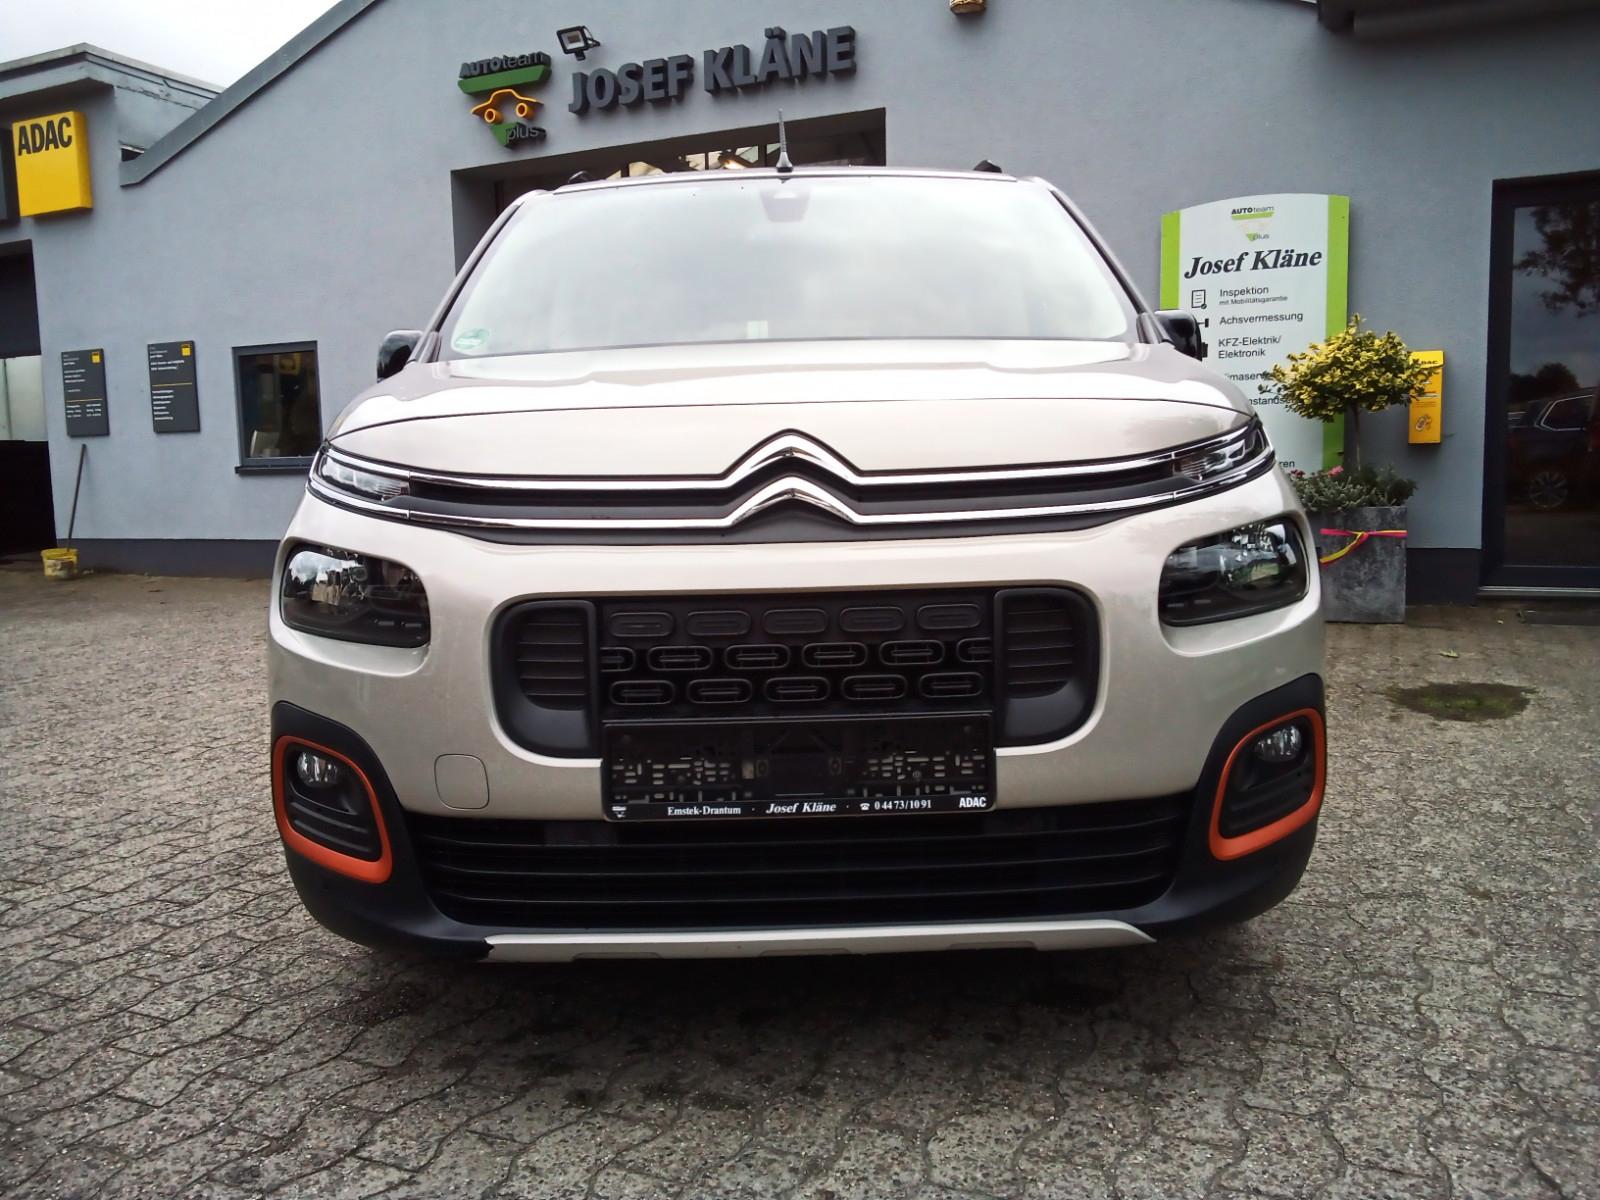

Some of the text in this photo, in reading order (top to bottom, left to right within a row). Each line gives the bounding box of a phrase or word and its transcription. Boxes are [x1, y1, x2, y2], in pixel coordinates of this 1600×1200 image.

[569, 26, 856, 113] JOSEF KLÄNE
[17, 115, 73, 157] ADAC
[506, 122, 541, 143] plus
[1184, 249, 1322, 279] Josef Kläne
[1219, 286, 1269, 298] Inspektion
[1219, 312, 1304, 325] Achsvermessung
[1218, 335, 1282, 348] KFZ-Elektrik/
[1218, 348, 1266, 359] Elektronik
[667, 805, 742, 816] Emstek-Drantum
[766, 802, 799, 814] Josef
[802, 801, 837, 813] Kläne
[959, 796, 987, 808] ADAC
